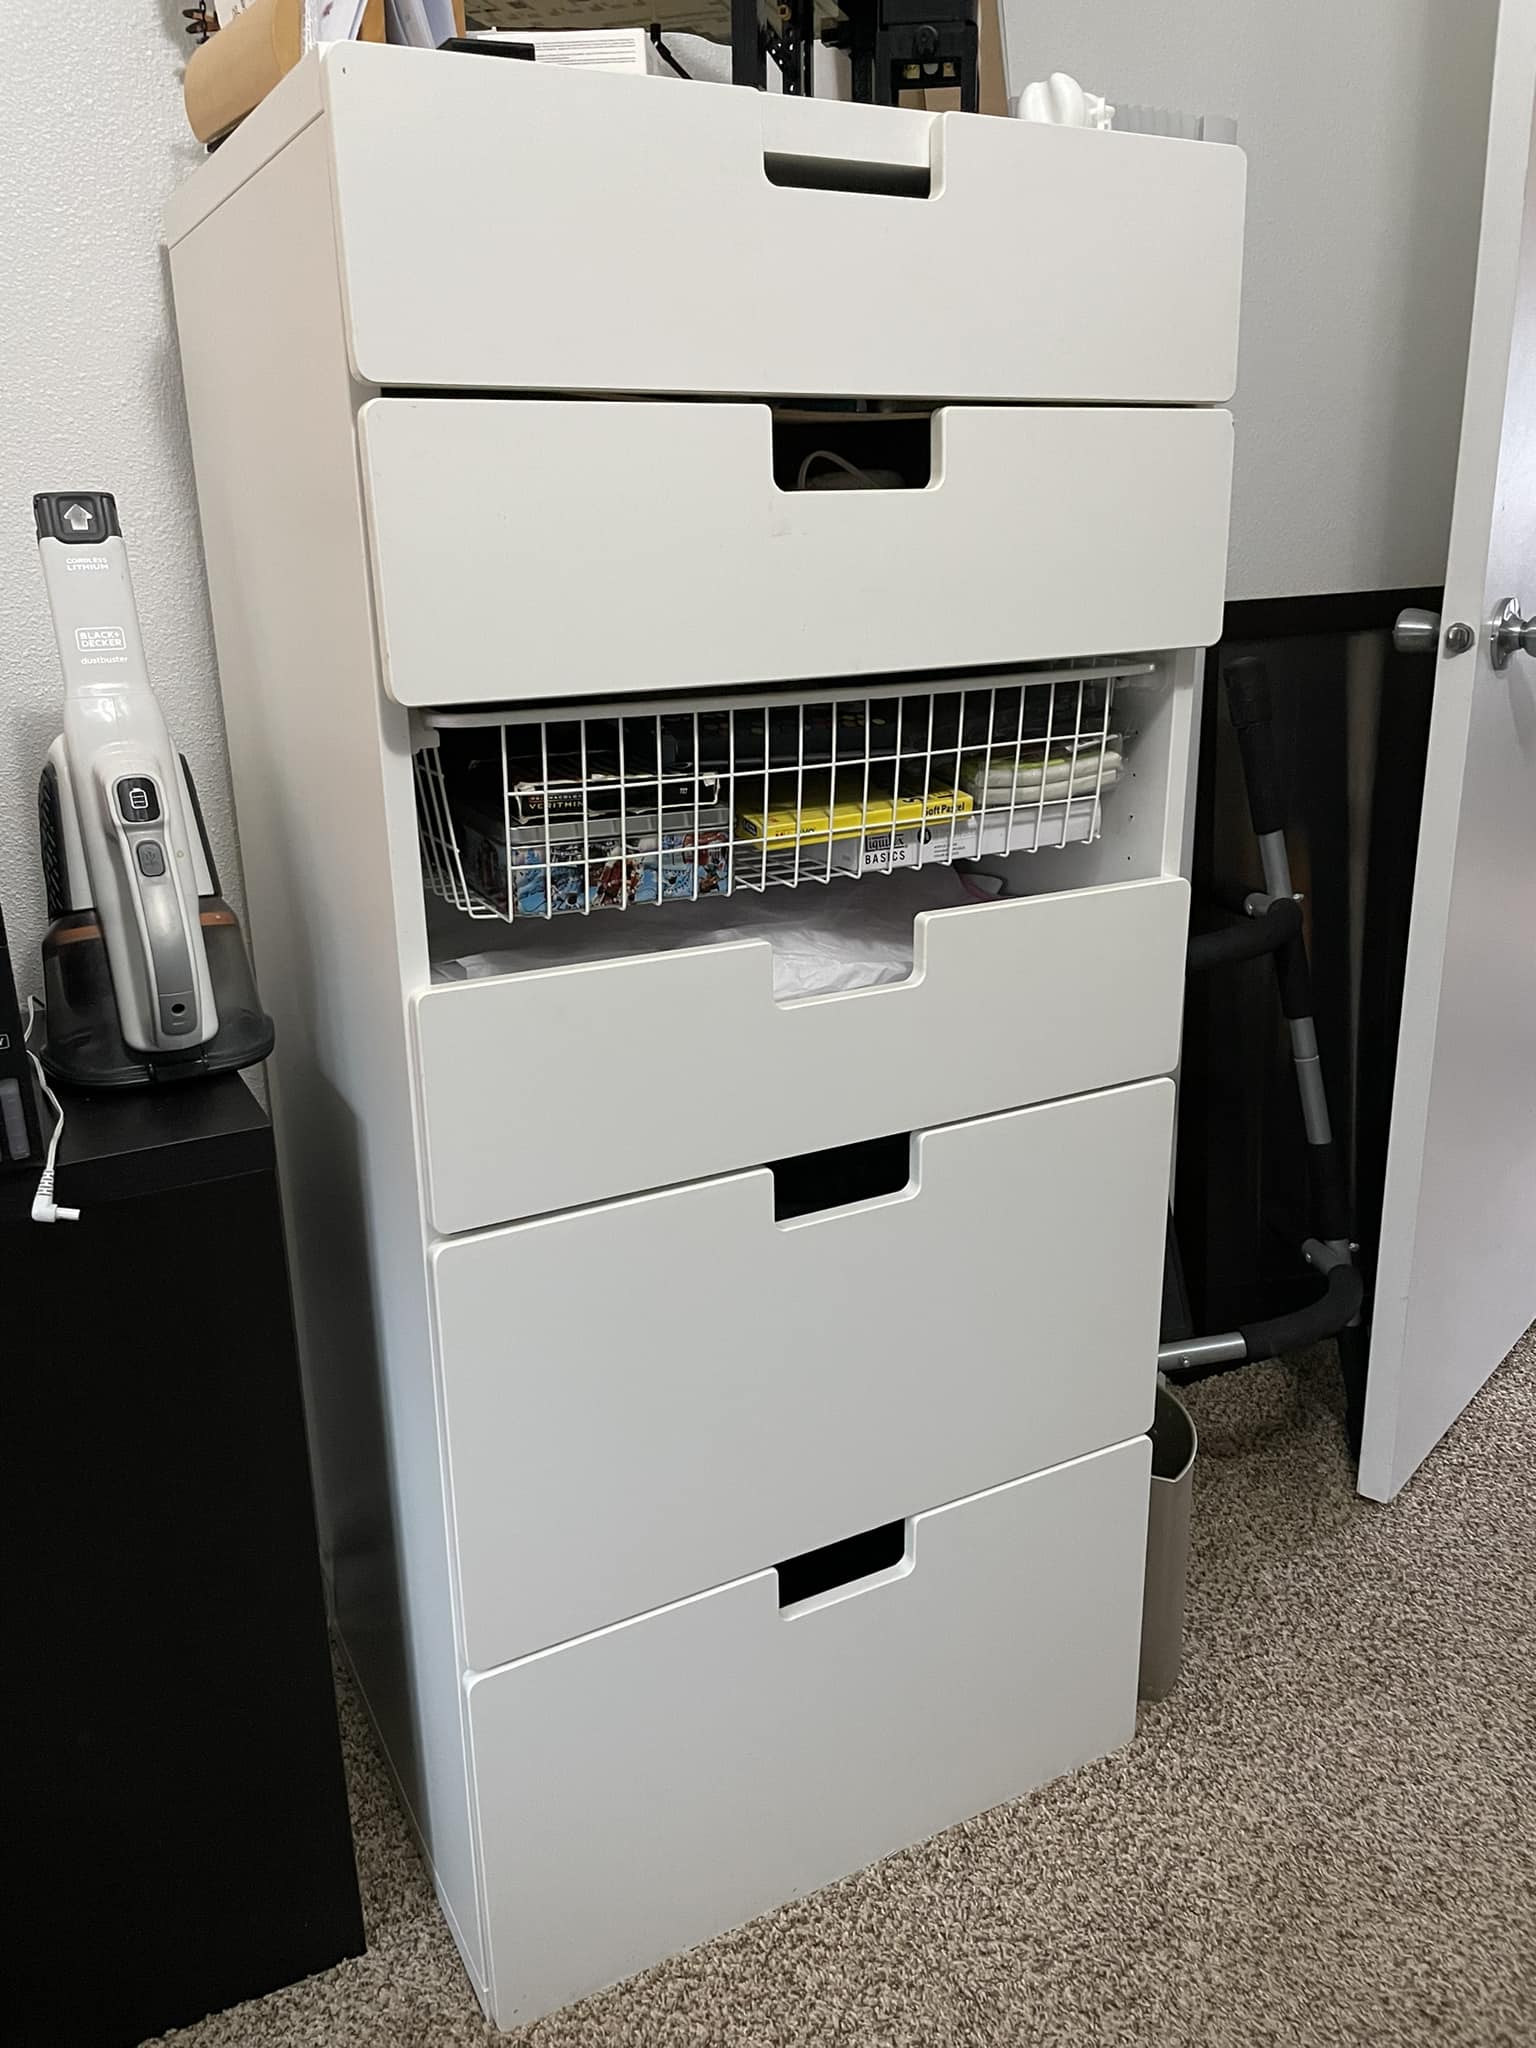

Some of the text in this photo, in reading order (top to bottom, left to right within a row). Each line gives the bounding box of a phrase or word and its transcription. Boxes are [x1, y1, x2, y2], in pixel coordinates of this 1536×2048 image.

[66, 563, 109, 571] LITHIUM
[81, 639, 122, 648] DECKER
[80, 656, 128, 665] dustbuster
[941, 802, 965, 814] Pael
[865, 832, 904, 852] Liquitx
[865, 850, 906, 865] BASICS
